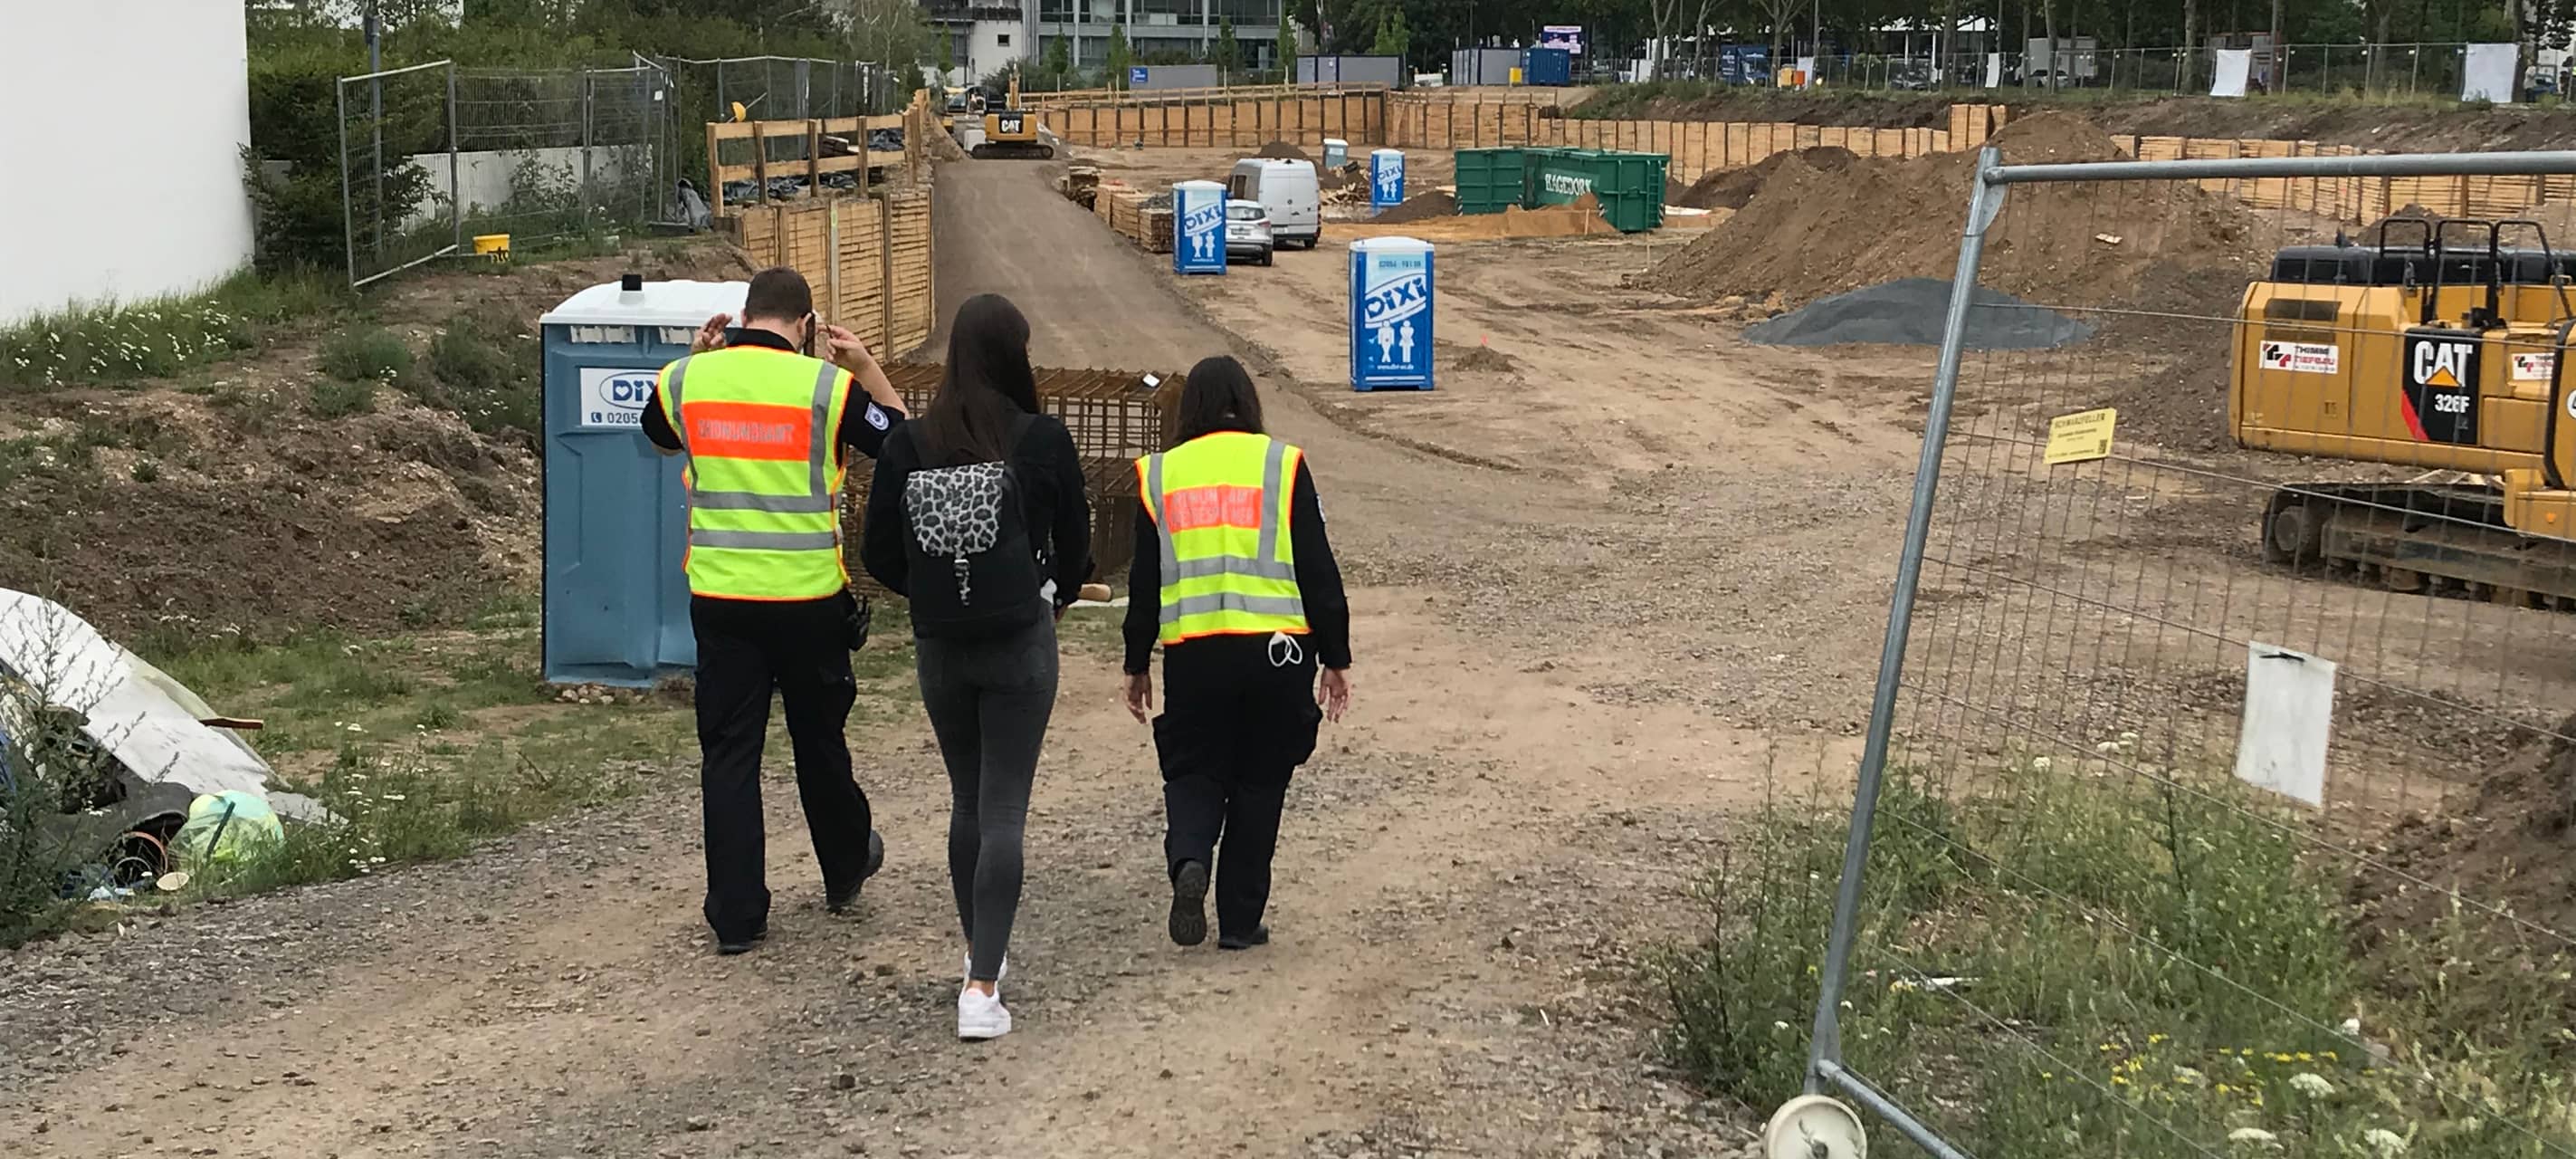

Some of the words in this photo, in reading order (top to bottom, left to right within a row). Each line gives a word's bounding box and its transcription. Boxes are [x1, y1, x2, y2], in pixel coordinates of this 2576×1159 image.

[1001, 120, 1021, 132] CAT
[2413, 340, 2474, 388] CAT
[2434, 393, 2470, 413] 326F
[607, 412, 638, 424] 0205
